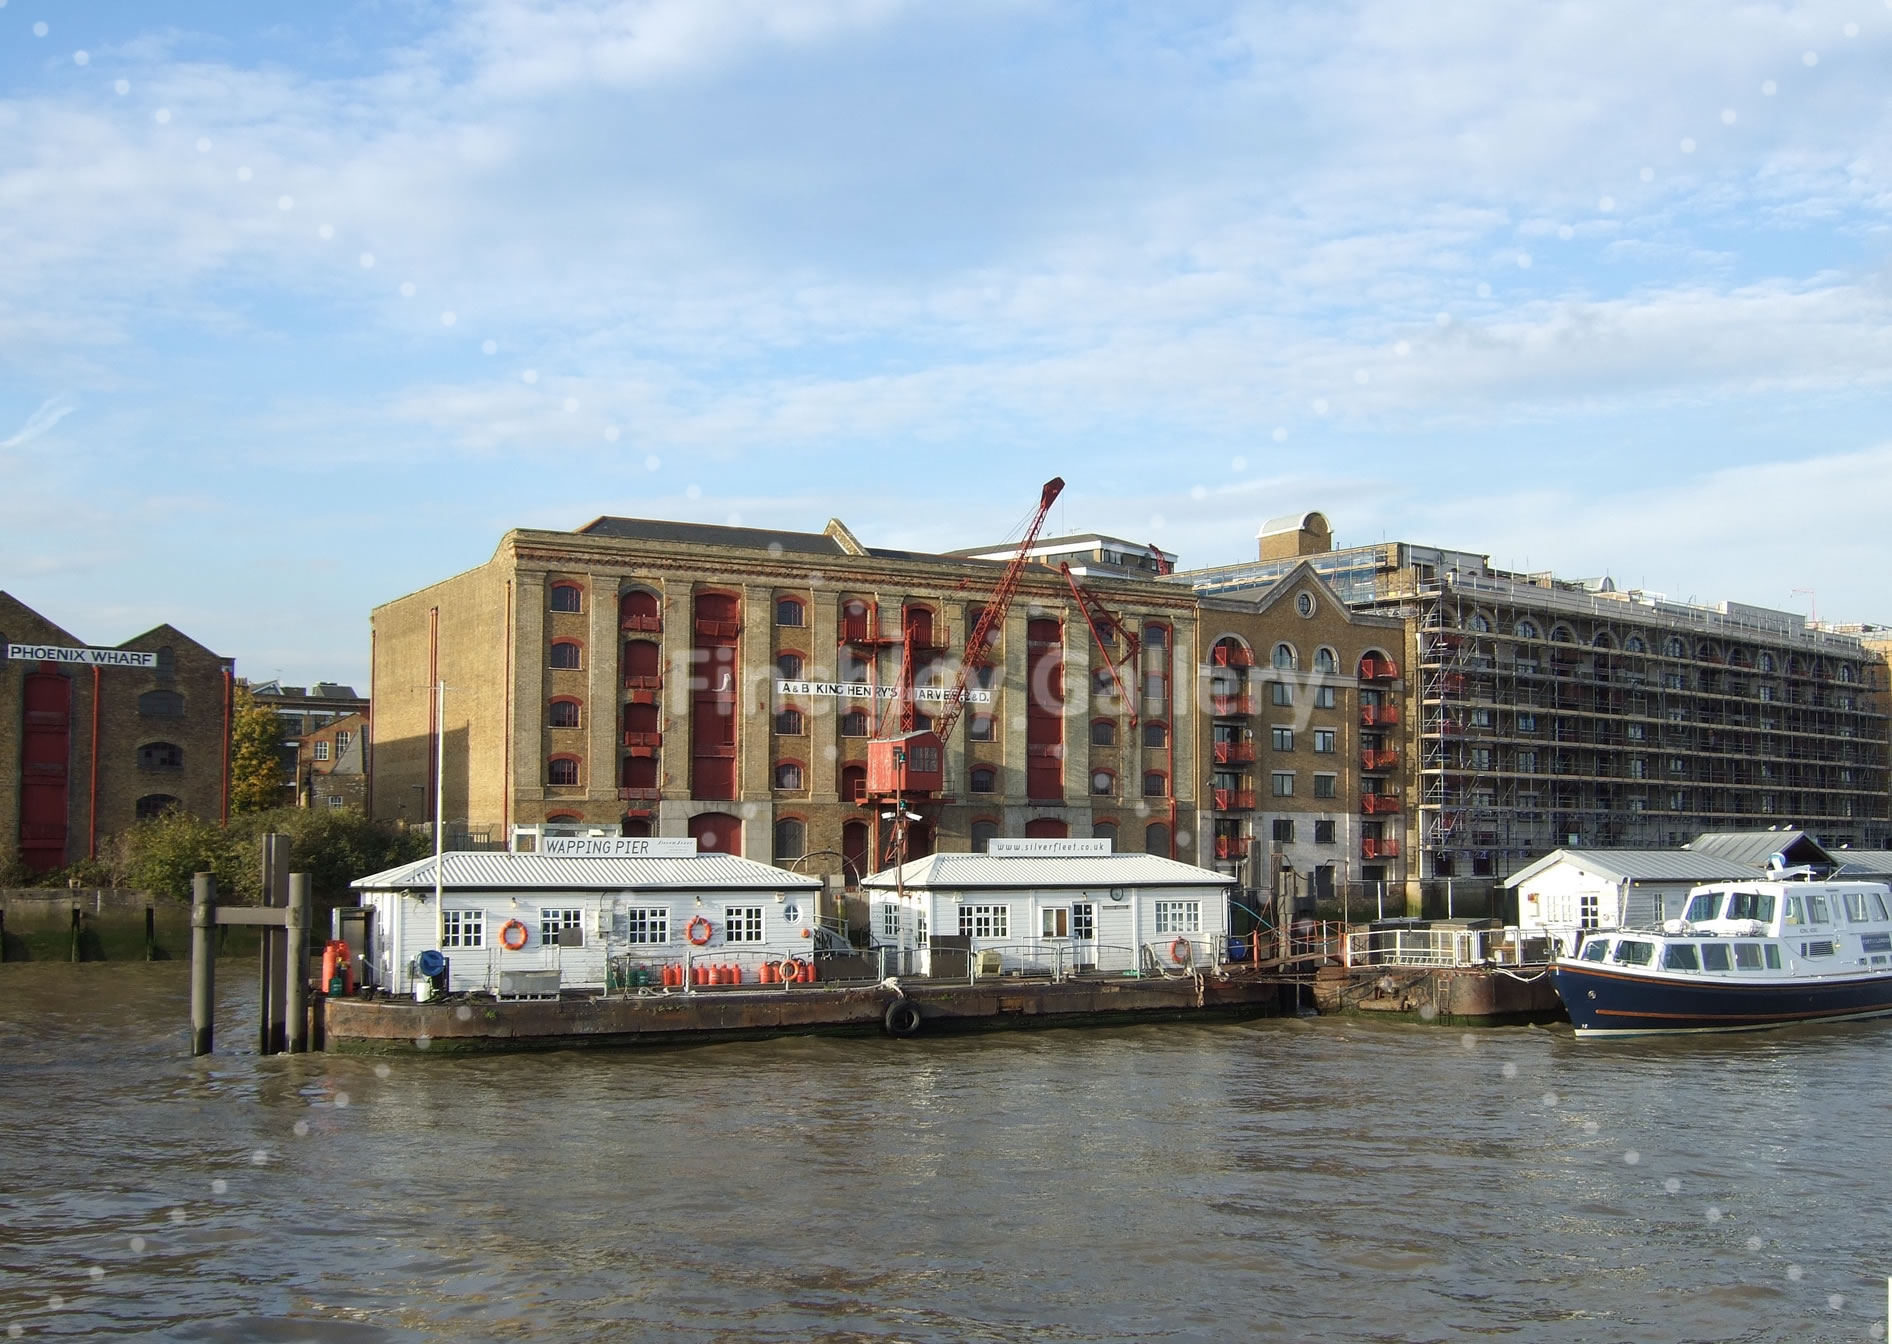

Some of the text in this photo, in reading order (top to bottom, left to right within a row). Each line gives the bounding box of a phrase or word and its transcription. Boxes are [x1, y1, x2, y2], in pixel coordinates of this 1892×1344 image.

[11, 646, 152, 665] PHOENIX WHARF
[782, 683, 791, 693] A
[792, 684, 799, 693] &
[801, 683, 810, 693] B
[816, 684, 844, 695] KING
[847, 685, 898, 698] HENRY'S
[546, 840, 649, 854] WAPPING PIER
[997, 842, 1104, 853] www.silverfleet.co.uk
